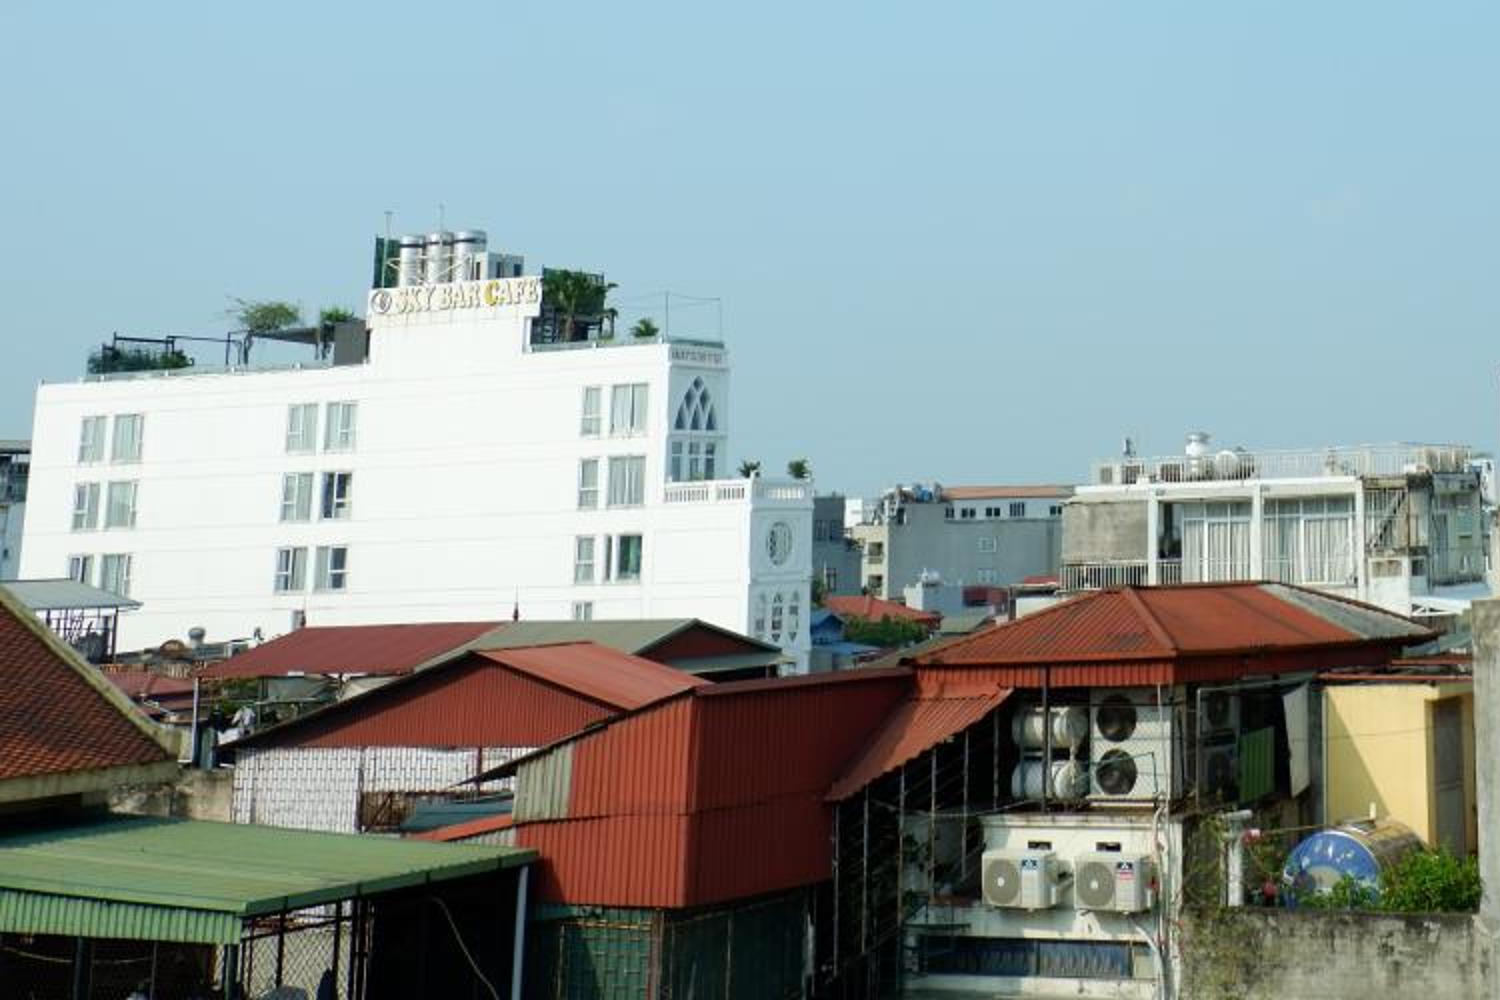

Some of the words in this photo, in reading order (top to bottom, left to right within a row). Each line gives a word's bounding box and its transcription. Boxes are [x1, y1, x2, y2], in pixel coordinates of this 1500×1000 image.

[396, 287, 435, 313] SKY
[438, 282, 481, 310] BAR
[484, 278, 539, 306] CAFE
